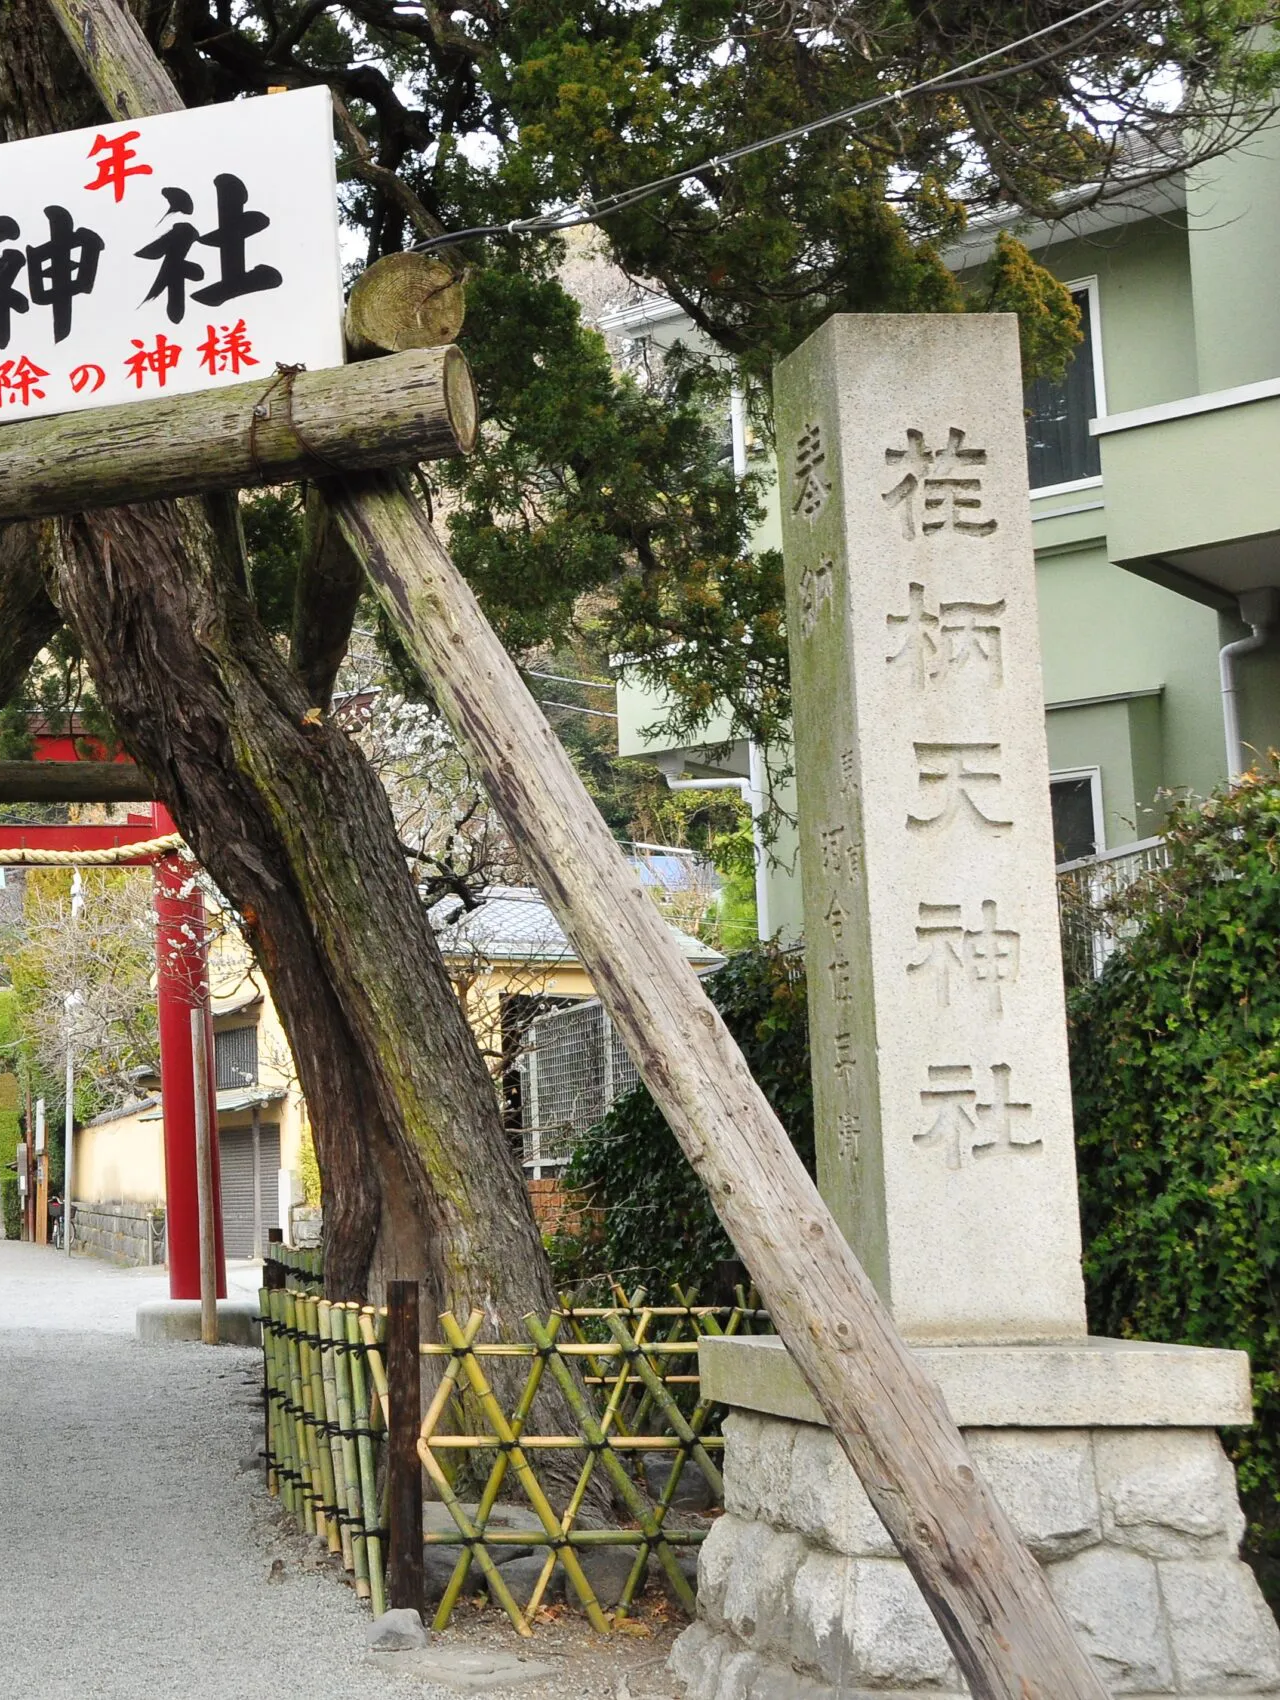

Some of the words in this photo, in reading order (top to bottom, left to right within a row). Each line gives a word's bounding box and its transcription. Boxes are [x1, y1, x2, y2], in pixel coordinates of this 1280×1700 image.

[880, 426, 1044, 1171] 荏柄天神社
